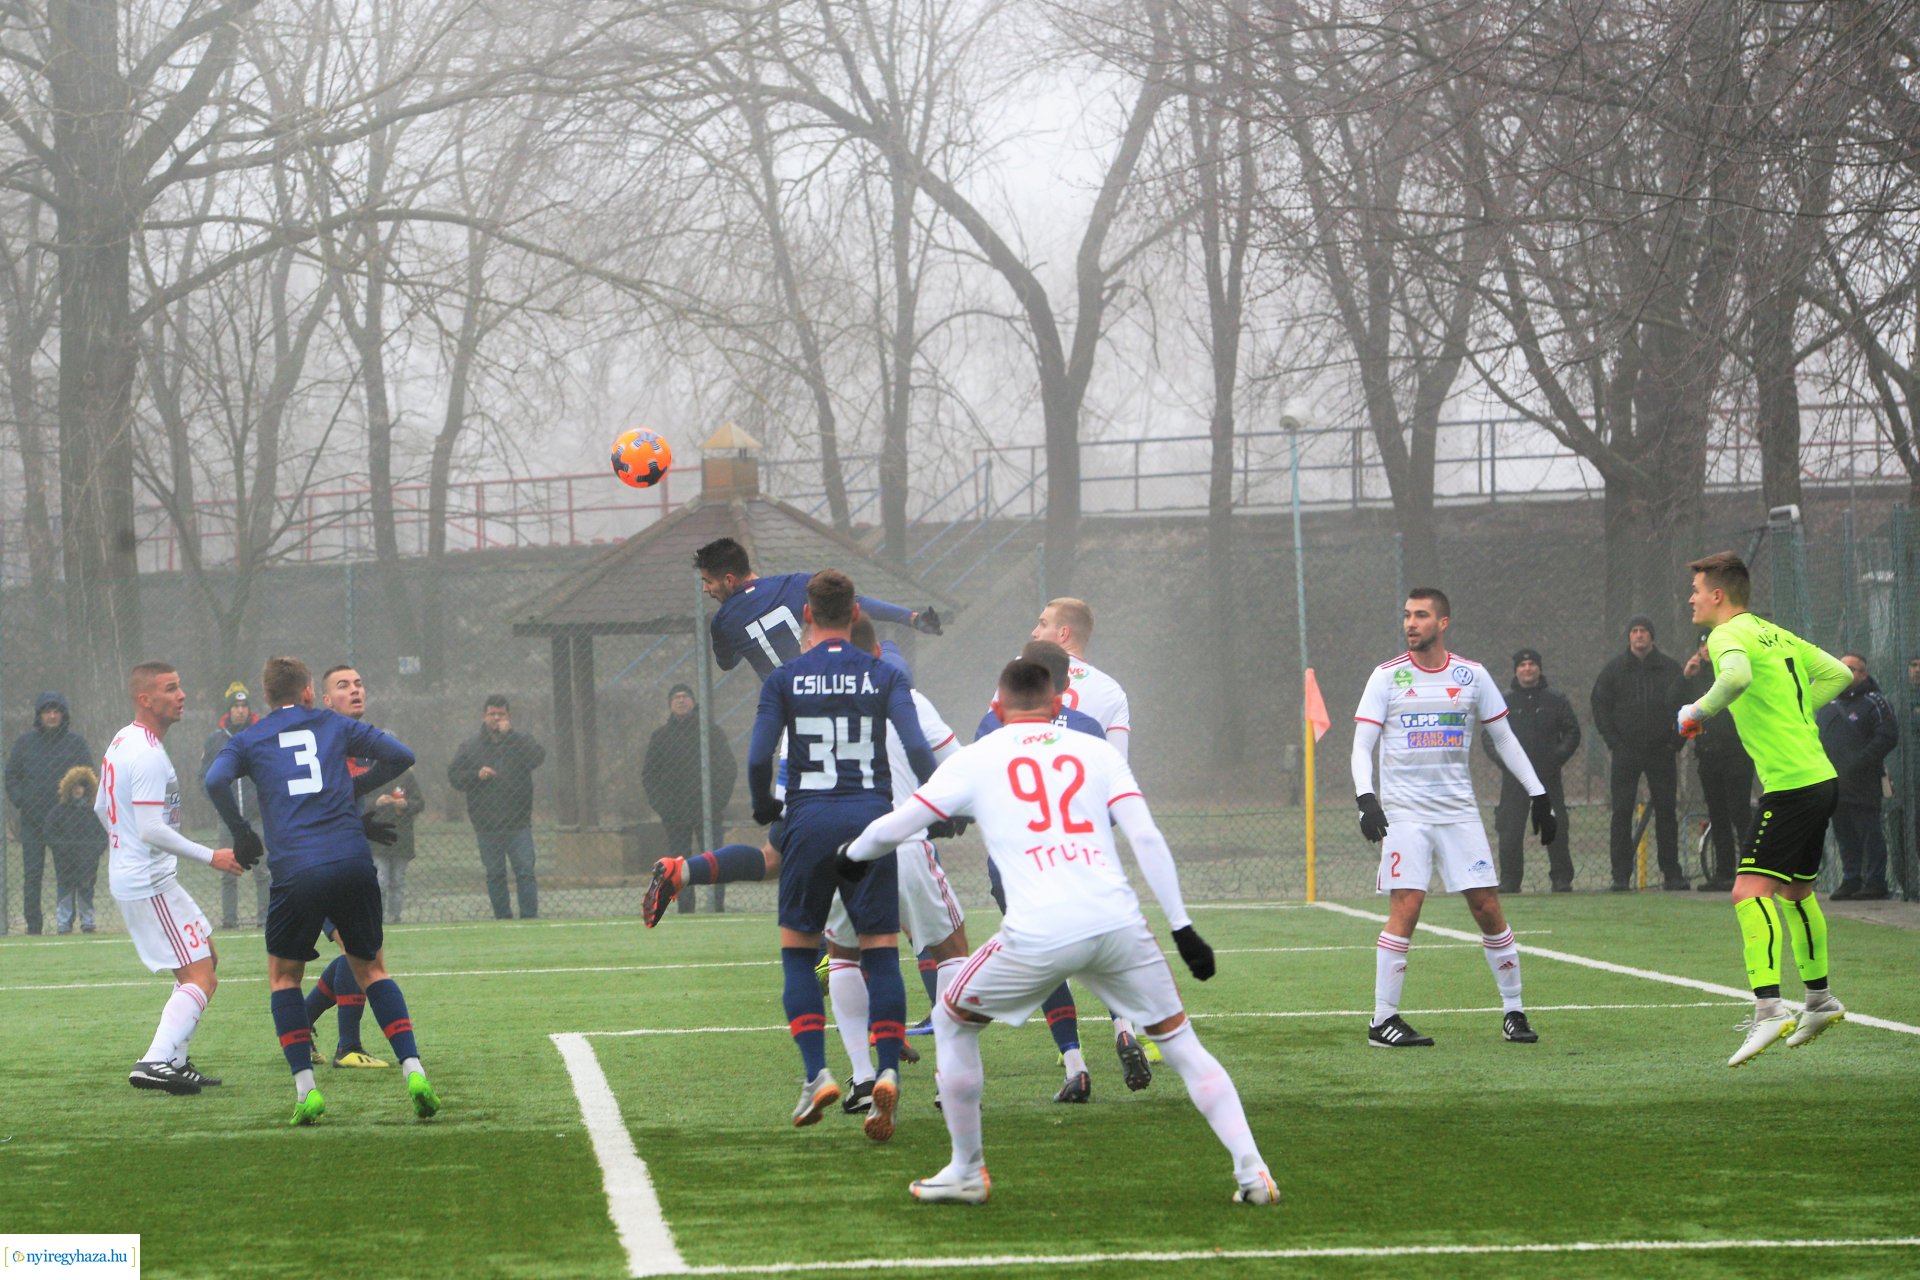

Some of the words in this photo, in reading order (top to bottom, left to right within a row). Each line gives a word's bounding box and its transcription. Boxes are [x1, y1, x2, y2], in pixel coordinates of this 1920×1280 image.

[745, 605, 803, 667] 17
[793, 674, 856, 695] CSILUS
[861, 671, 880, 695] Á.
[1784, 657, 1808, 725] 1
[278, 729, 323, 796] 3
[795, 716, 876, 791] 34
[1007, 754, 1094, 834] 92
[1391, 851, 1401, 878] 2
